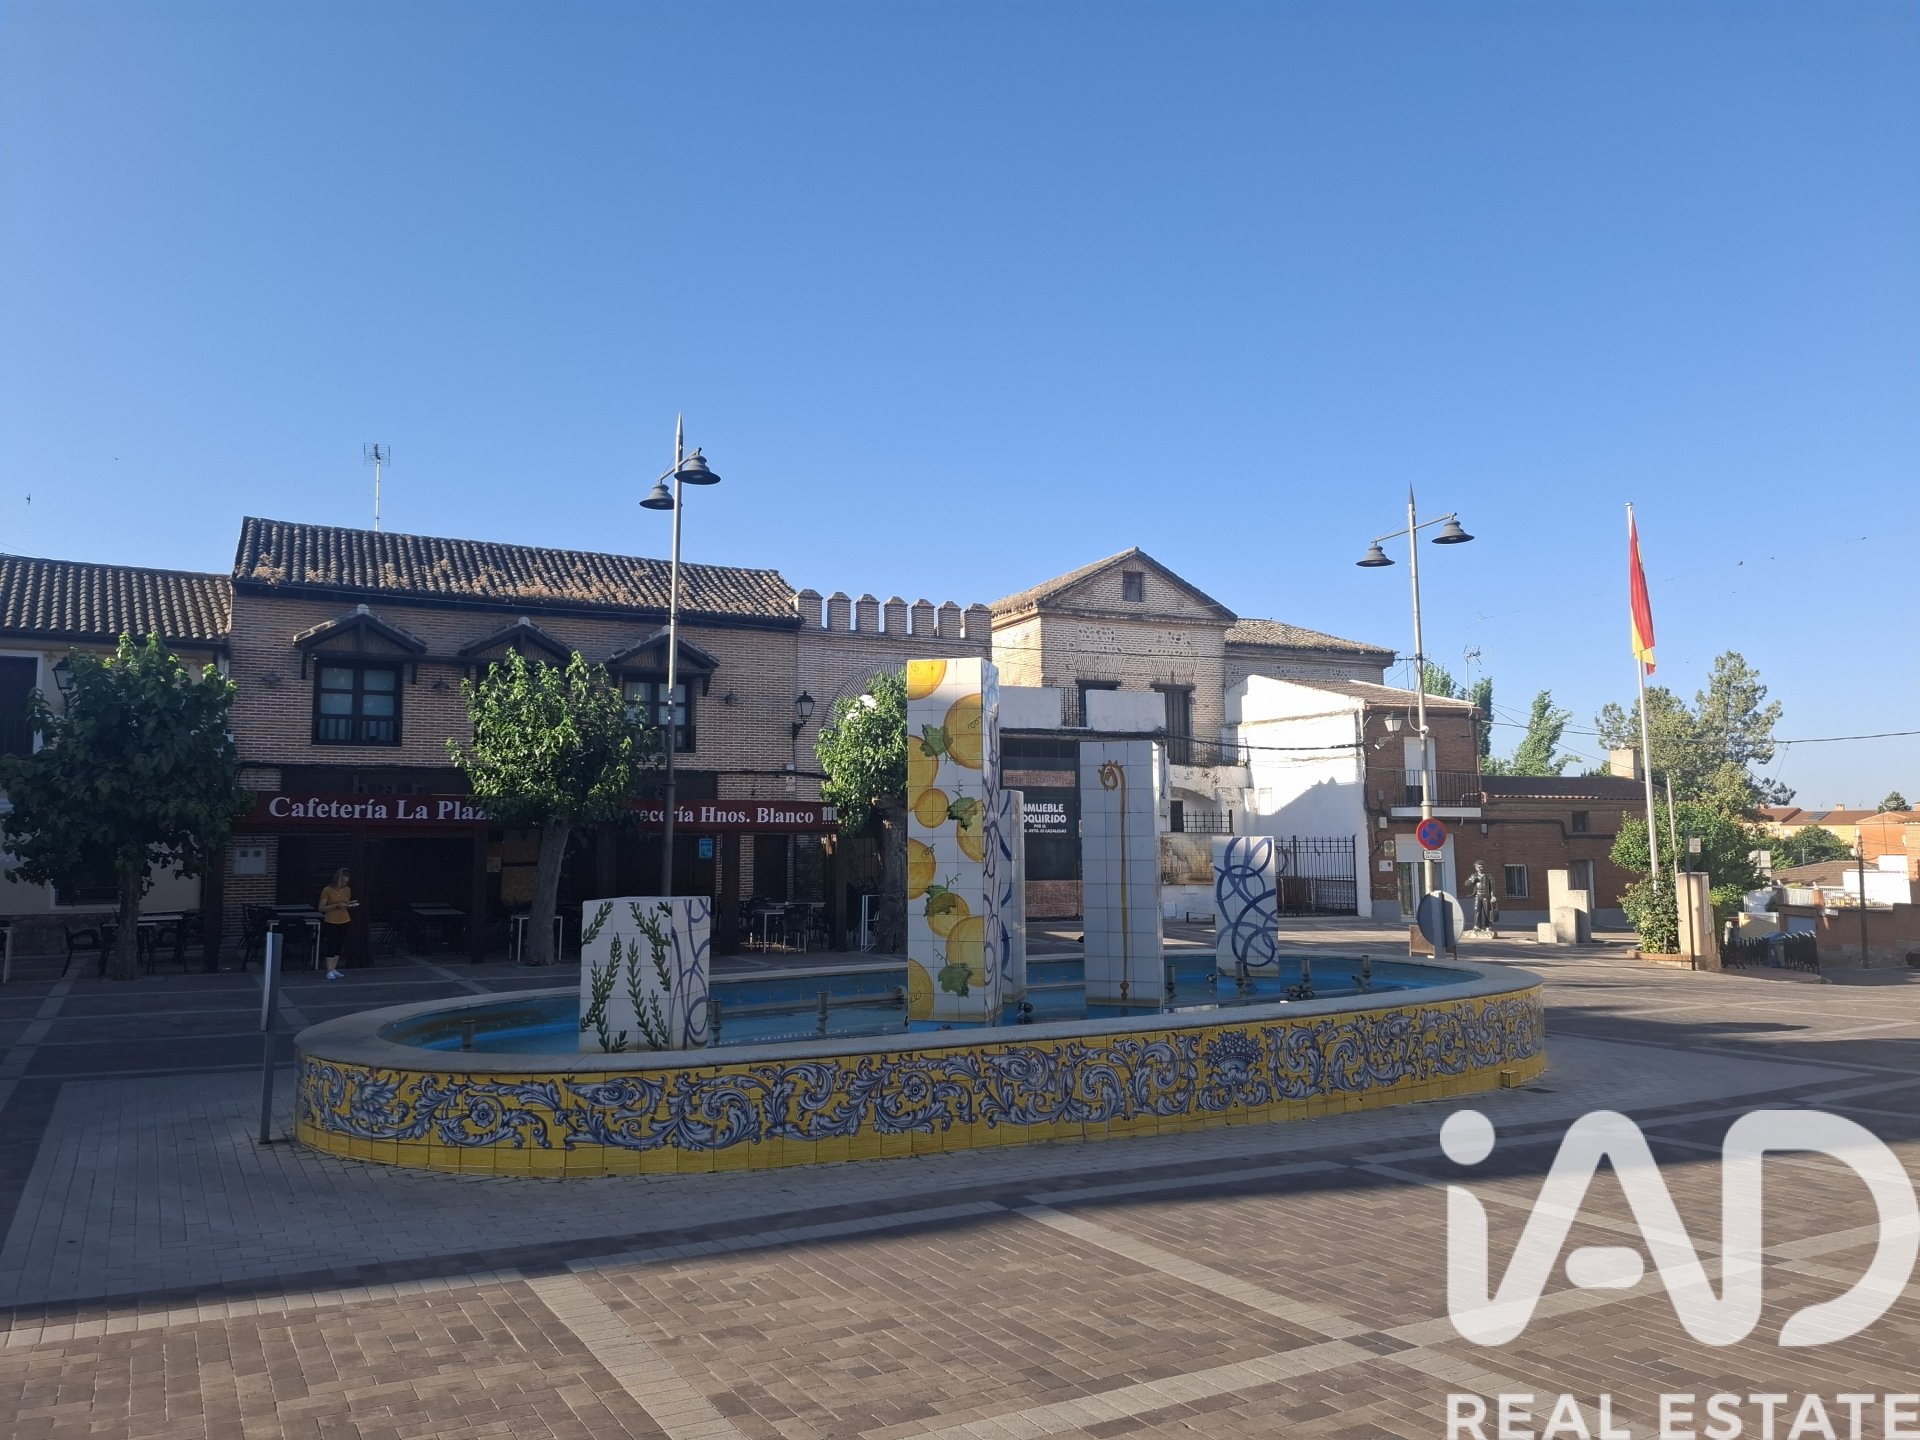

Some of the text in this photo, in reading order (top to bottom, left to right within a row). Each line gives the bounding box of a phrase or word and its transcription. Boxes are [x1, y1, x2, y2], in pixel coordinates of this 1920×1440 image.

[268, 797, 497, 820] Cafetería La Plaz
[700, 806, 750, 823] Hnos.
[756, 807, 814, 824] Blanco
[1023, 803, 1064, 813] NMUEBLE
[1023, 814, 1067, 824] DQUIRIDO
